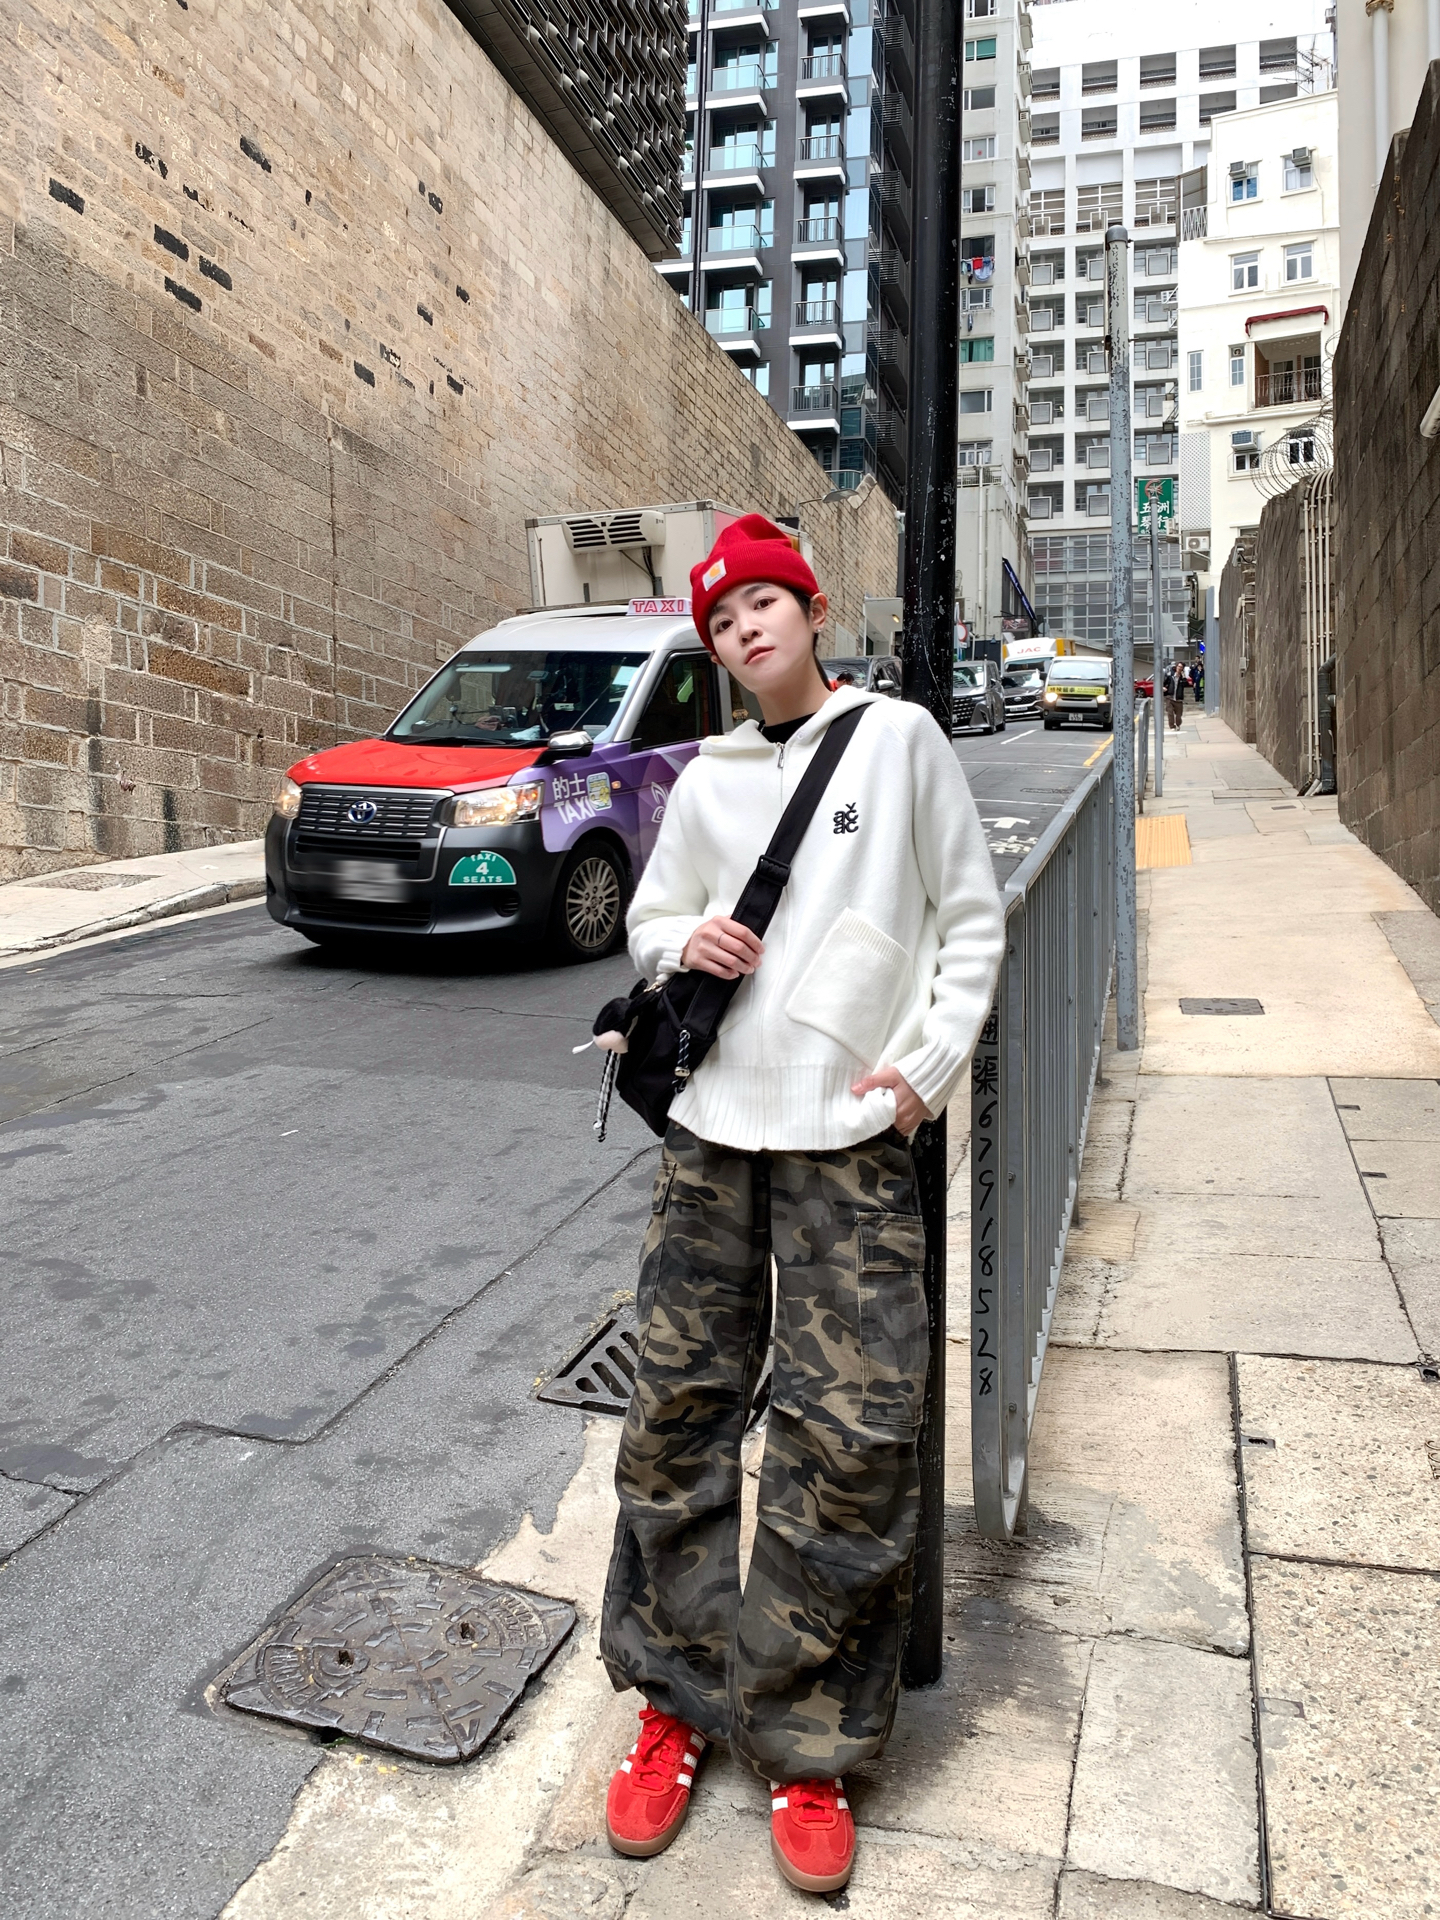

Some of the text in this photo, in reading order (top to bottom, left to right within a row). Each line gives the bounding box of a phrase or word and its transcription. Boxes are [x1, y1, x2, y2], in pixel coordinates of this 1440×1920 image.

[632, 599, 685, 613] TAXI
[1017, 646, 1041, 654] JAC
[552, 773, 586, 800] 的士
[553, 795, 597, 825] TAXI
[470, 853, 497, 862] TAXI
[475, 861, 489, 875] 4
[462, 875, 503, 883] SEATS
